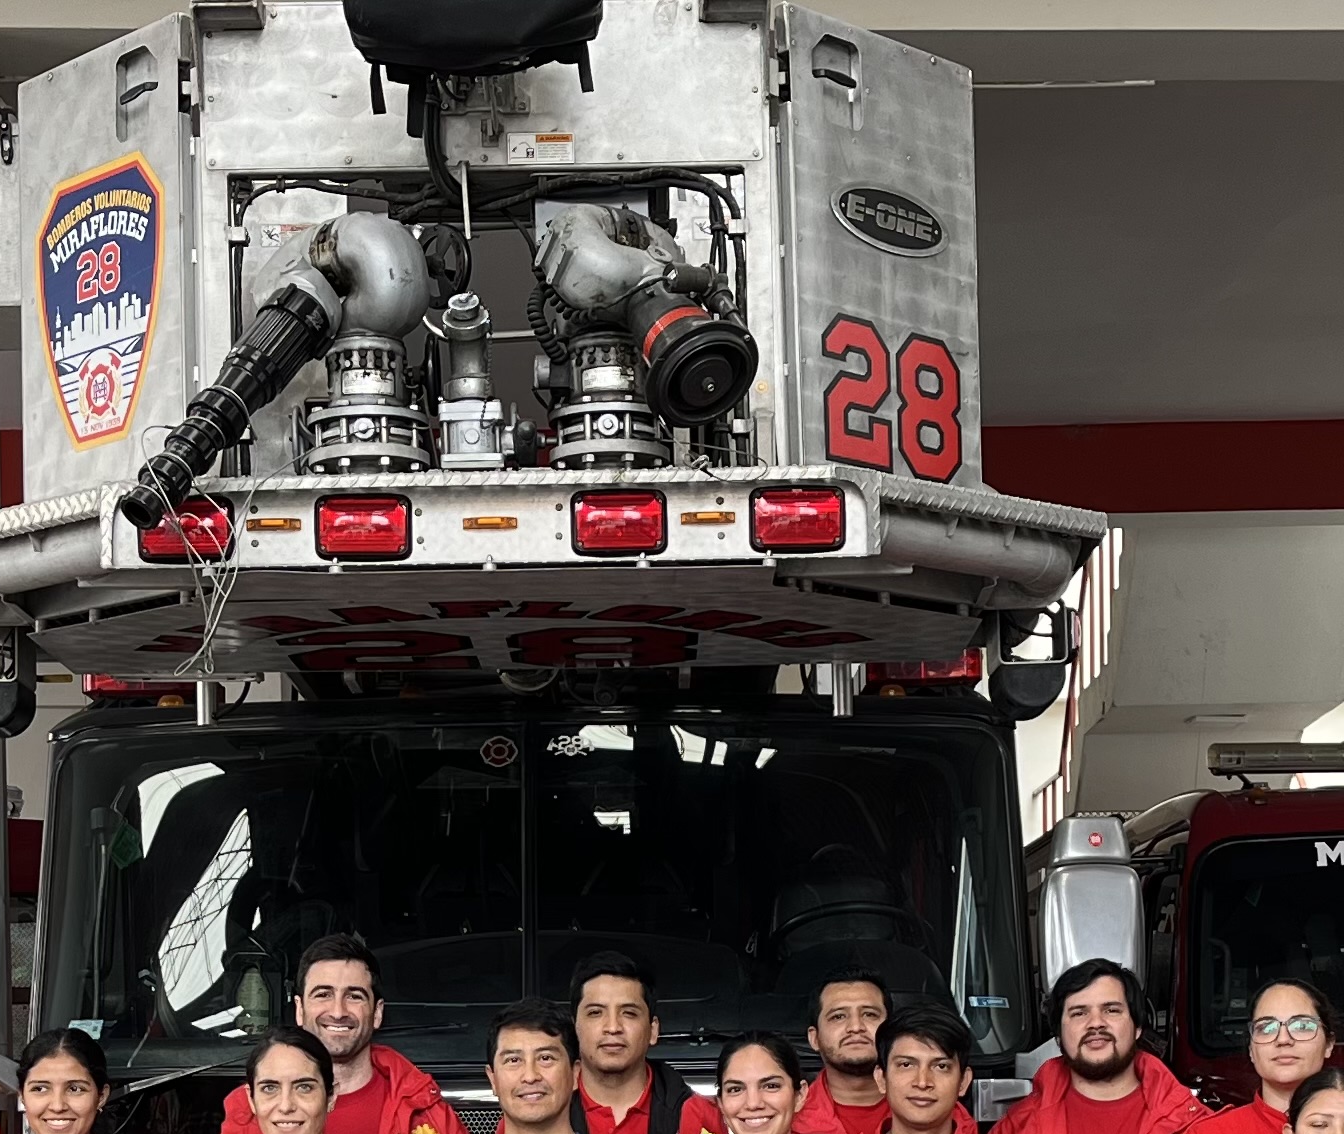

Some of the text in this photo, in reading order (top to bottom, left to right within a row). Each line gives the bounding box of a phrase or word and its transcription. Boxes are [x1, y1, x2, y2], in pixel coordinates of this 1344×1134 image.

[46, 189, 153, 250] BOMBEROS VOLUNTARIOS
[49, 210, 149, 273] MIRAFLORES
[846, 193, 933, 242] E-ONE
[76, 240, 121, 304] 28
[821, 312, 963, 484] 28
[276, 621, 700, 671] 28
